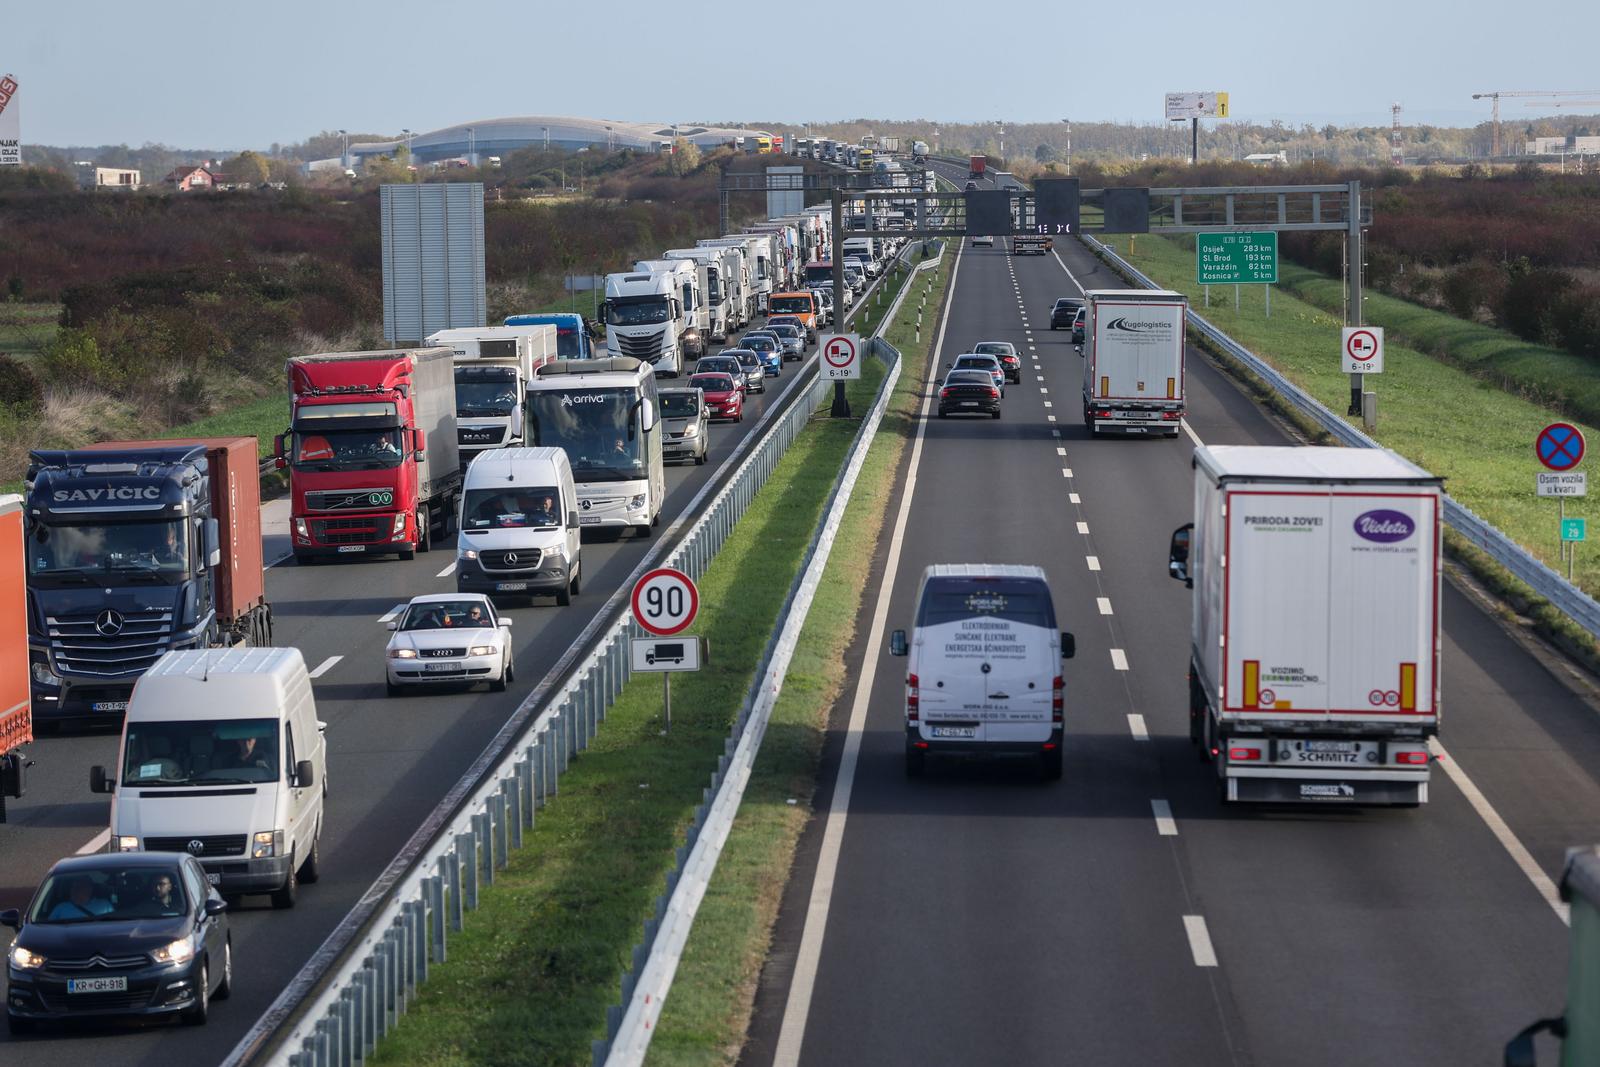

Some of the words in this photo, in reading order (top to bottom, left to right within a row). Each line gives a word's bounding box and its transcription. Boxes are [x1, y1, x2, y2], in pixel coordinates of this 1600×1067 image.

[1203, 246, 1225, 254] Osijek
[1213, 254, 1231, 262] Brod
[1203, 263, 1237, 271] Varaždin
[1123, 321, 1172, 330] Yugologistics
[573, 394, 604, 404] arriva
[1540, 474, 1560, 484] Osim
[1561, 474, 1584, 484] vozila
[1547, 486, 1553, 494] u
[1554, 485, 1576, 494] kvaru
[372, 495, 378, 503] L
[1244, 515, 1290, 527] PRIRODA
[1292, 516, 1323, 527] ZOVE!
[1359, 516, 1410, 535] Violeta
[646, 586, 683, 618] 90
[954, 632, 982, 642] SUNČANE
[983, 633, 1017, 642] ELEKTRANE
[945, 644, 983, 653] ENERGETSKA
[1270, 667, 1304, 675] VOZIMO
[1298, 752, 1358, 764] SCHMITZ
[75, 981, 88, 991] KR
[94, 979, 124, 990] GH-918
